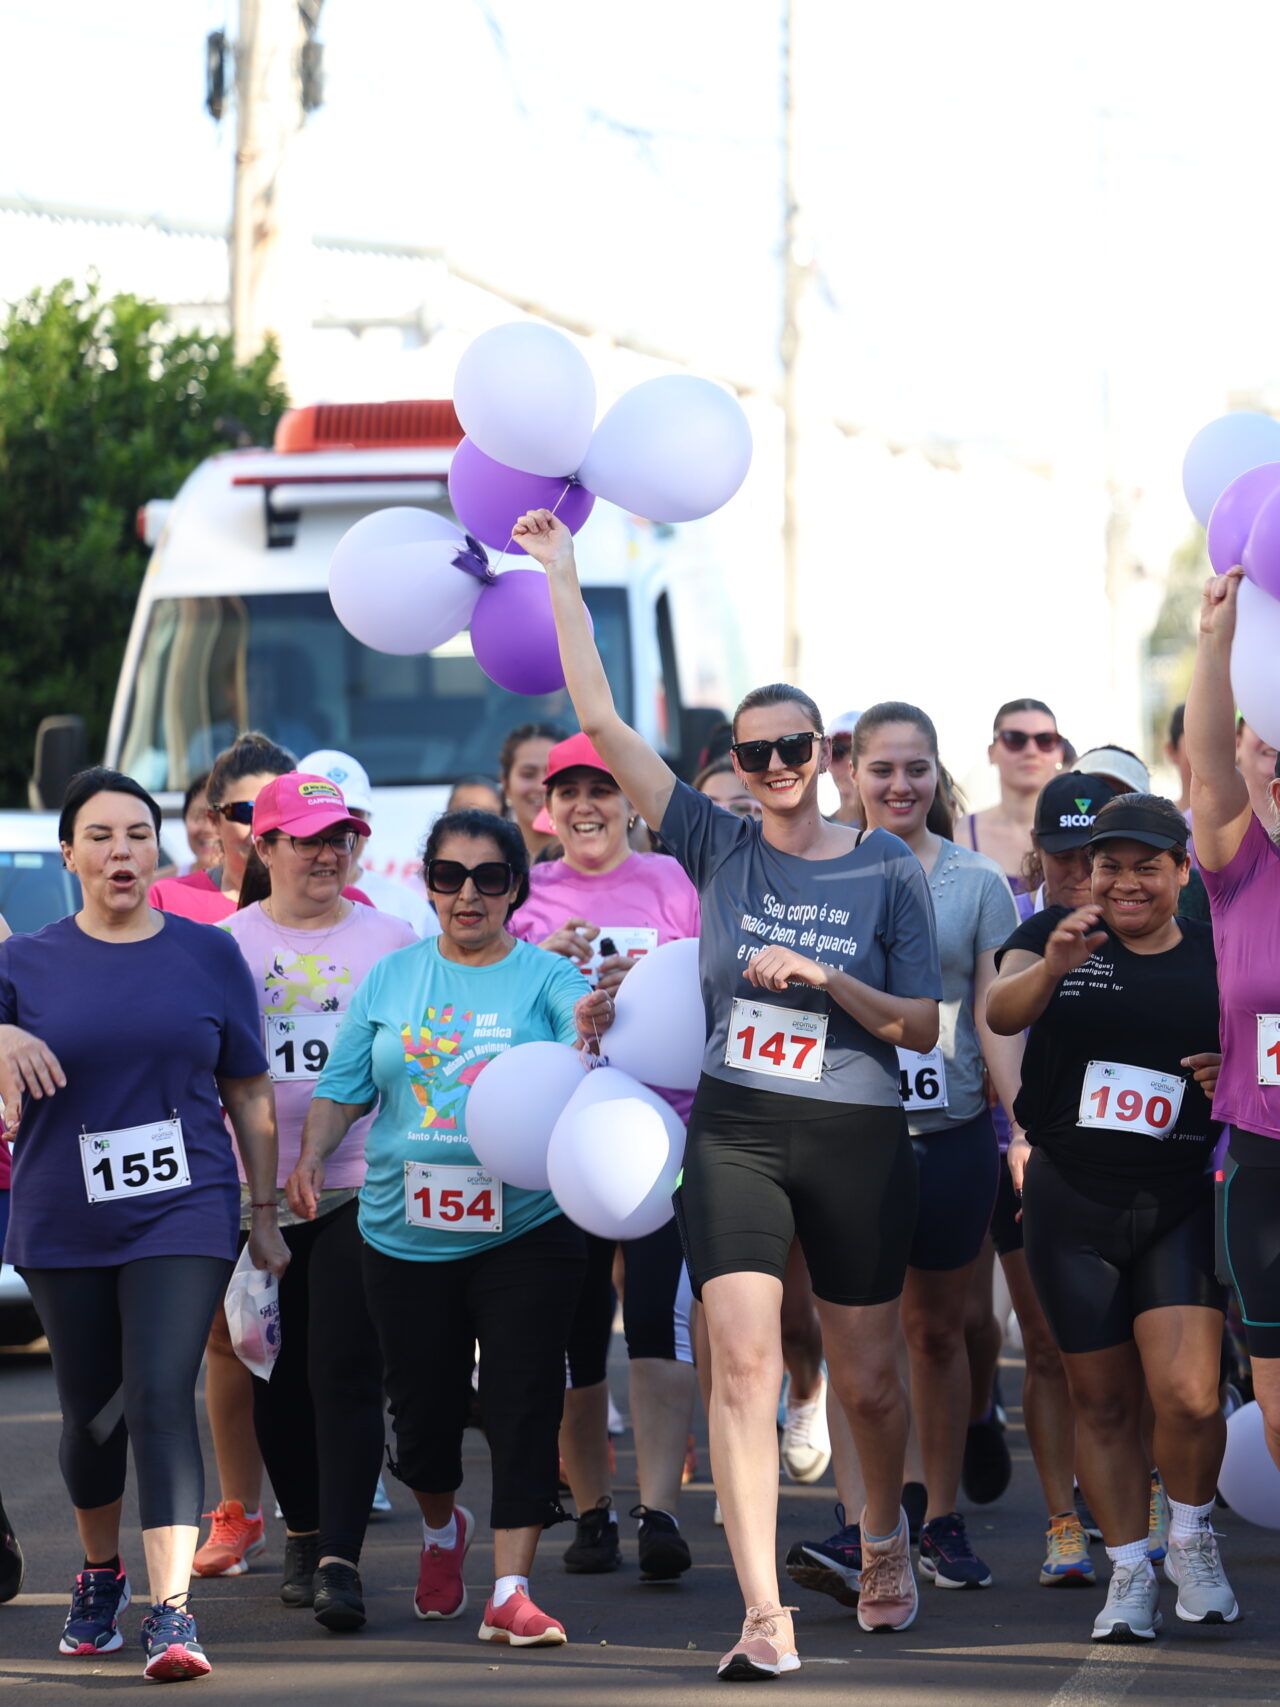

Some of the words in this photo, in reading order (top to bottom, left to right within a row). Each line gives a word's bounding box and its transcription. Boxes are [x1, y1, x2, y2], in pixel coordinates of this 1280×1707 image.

[787, 904, 818, 926] corpo
[820, 903, 828, 921] é
[828, 908, 851, 926] seu
[741, 914, 772, 938] maior
[769, 922, 797, 947] bem,
[800, 928, 817, 947] ele
[815, 936, 857, 956] guarda
[1089, 981, 1107, 989] vezes
[1112, 983, 1123, 991] for
[475, 1013, 498, 1027] VIII
[792, 1020, 818, 1031] promus
[275, 1039, 330, 1074] 19
[737, 1025, 818, 1070] 147
[898, 1067, 940, 1102] 46
[1091, 1085, 1172, 1129] 190
[407, 1131, 430, 1141] Santo
[92, 1146, 178, 1192] 155
[414, 1186, 496, 1222] 154
